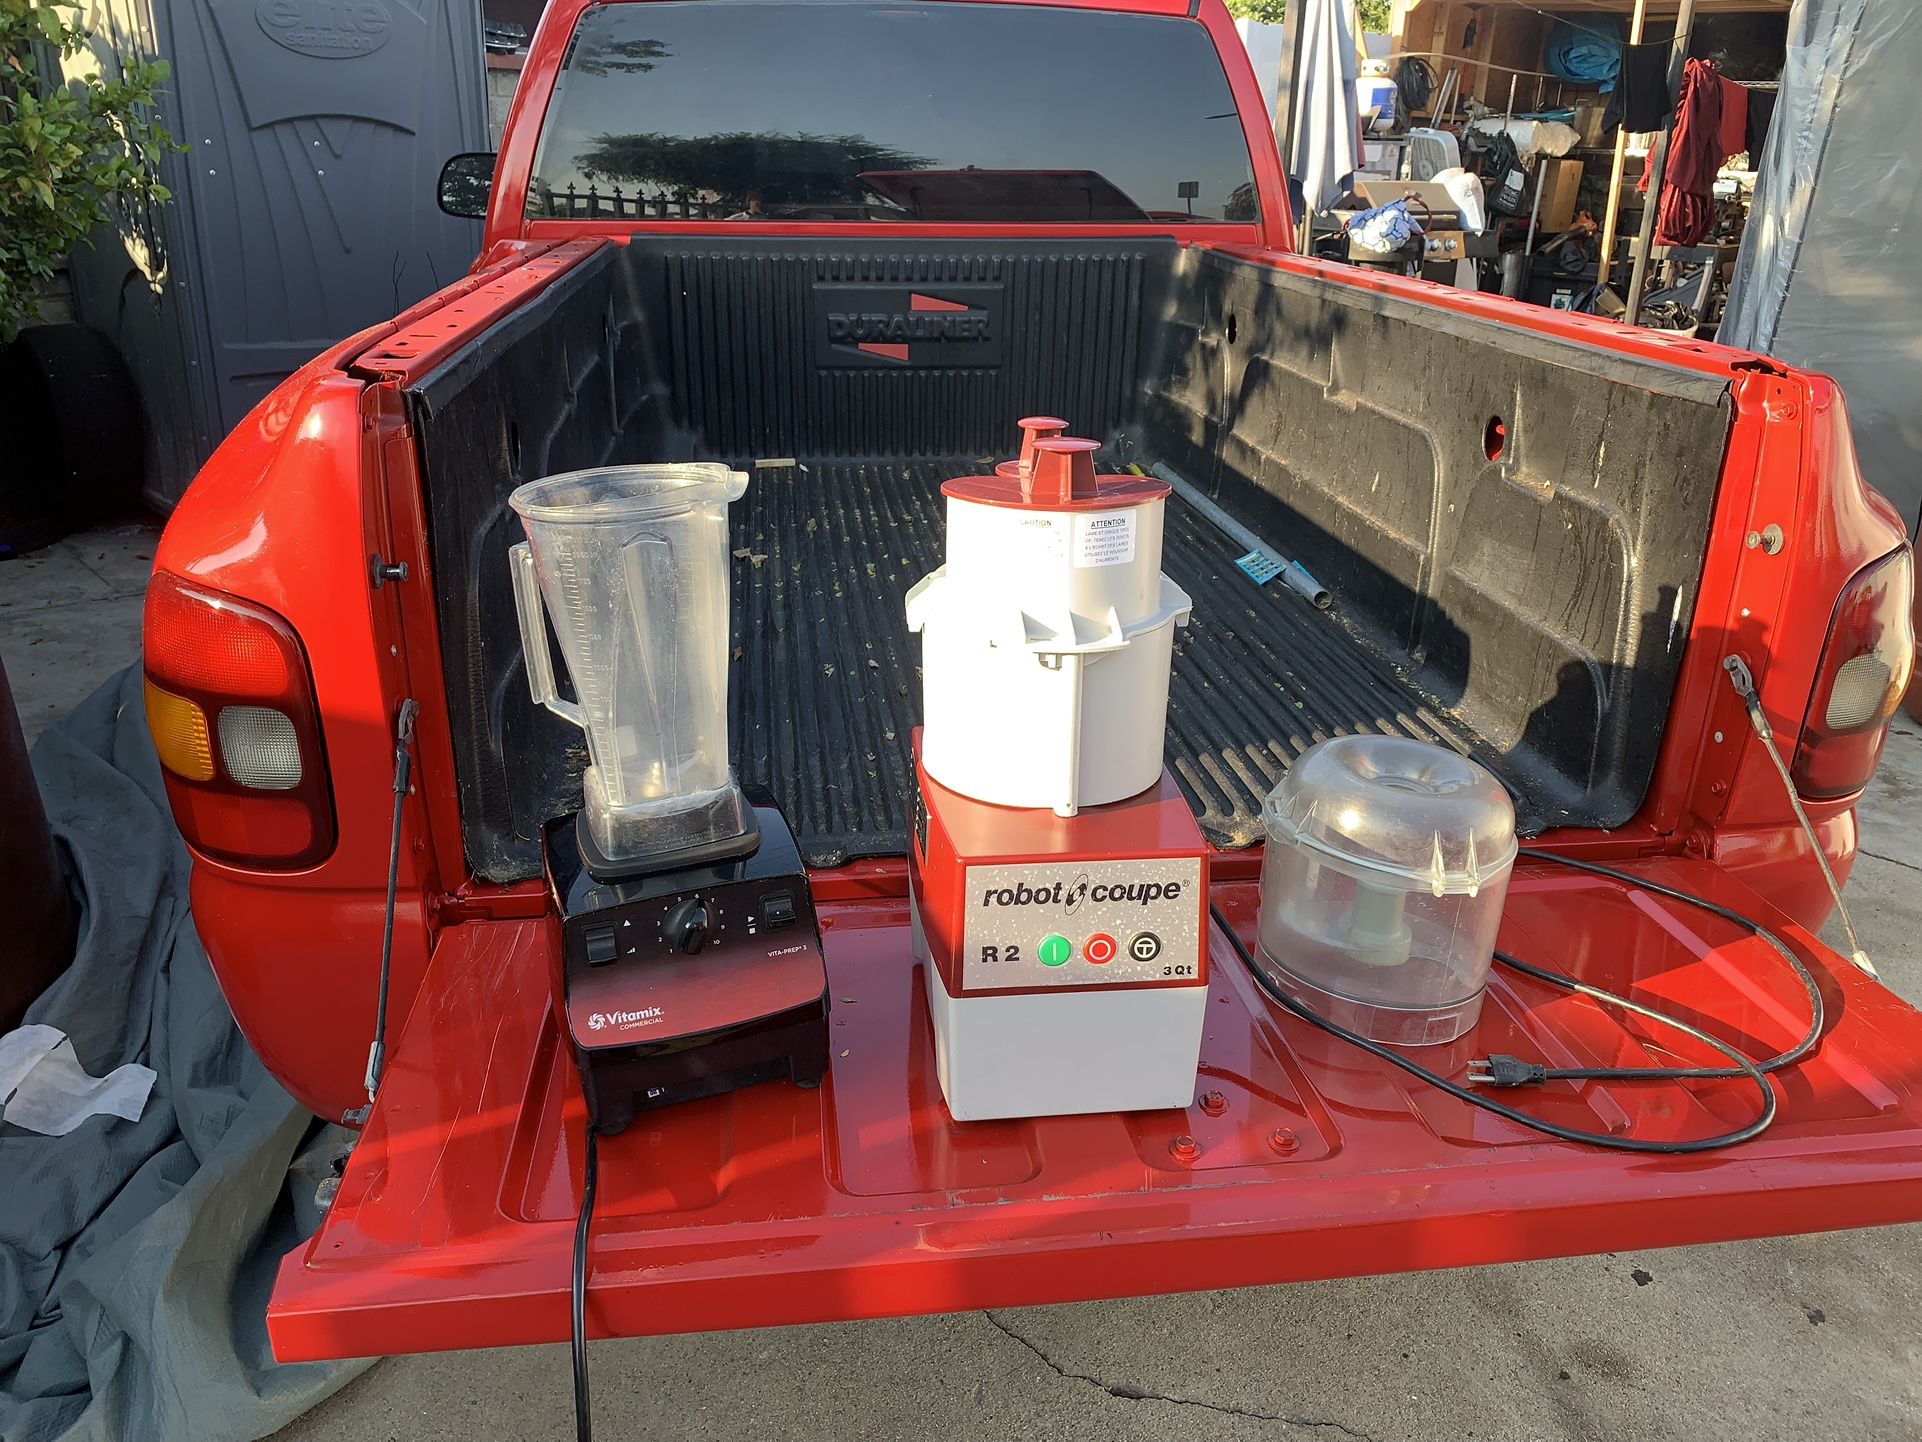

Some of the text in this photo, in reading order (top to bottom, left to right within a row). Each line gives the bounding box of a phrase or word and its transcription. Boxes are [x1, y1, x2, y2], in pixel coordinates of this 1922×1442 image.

[286, 33, 374, 51] sanitation
[827, 311, 991, 342] DURALINER
[1091, 517, 1126, 528] ATTENTION
[982, 881, 1063, 907] robot
[981, 945, 1020, 963] R 2
[1163, 965, 1193, 976] 3 Qt
[605, 1006, 662, 1025] Vitamix
[619, 1017, 664, 1031] COMMERCIAL
